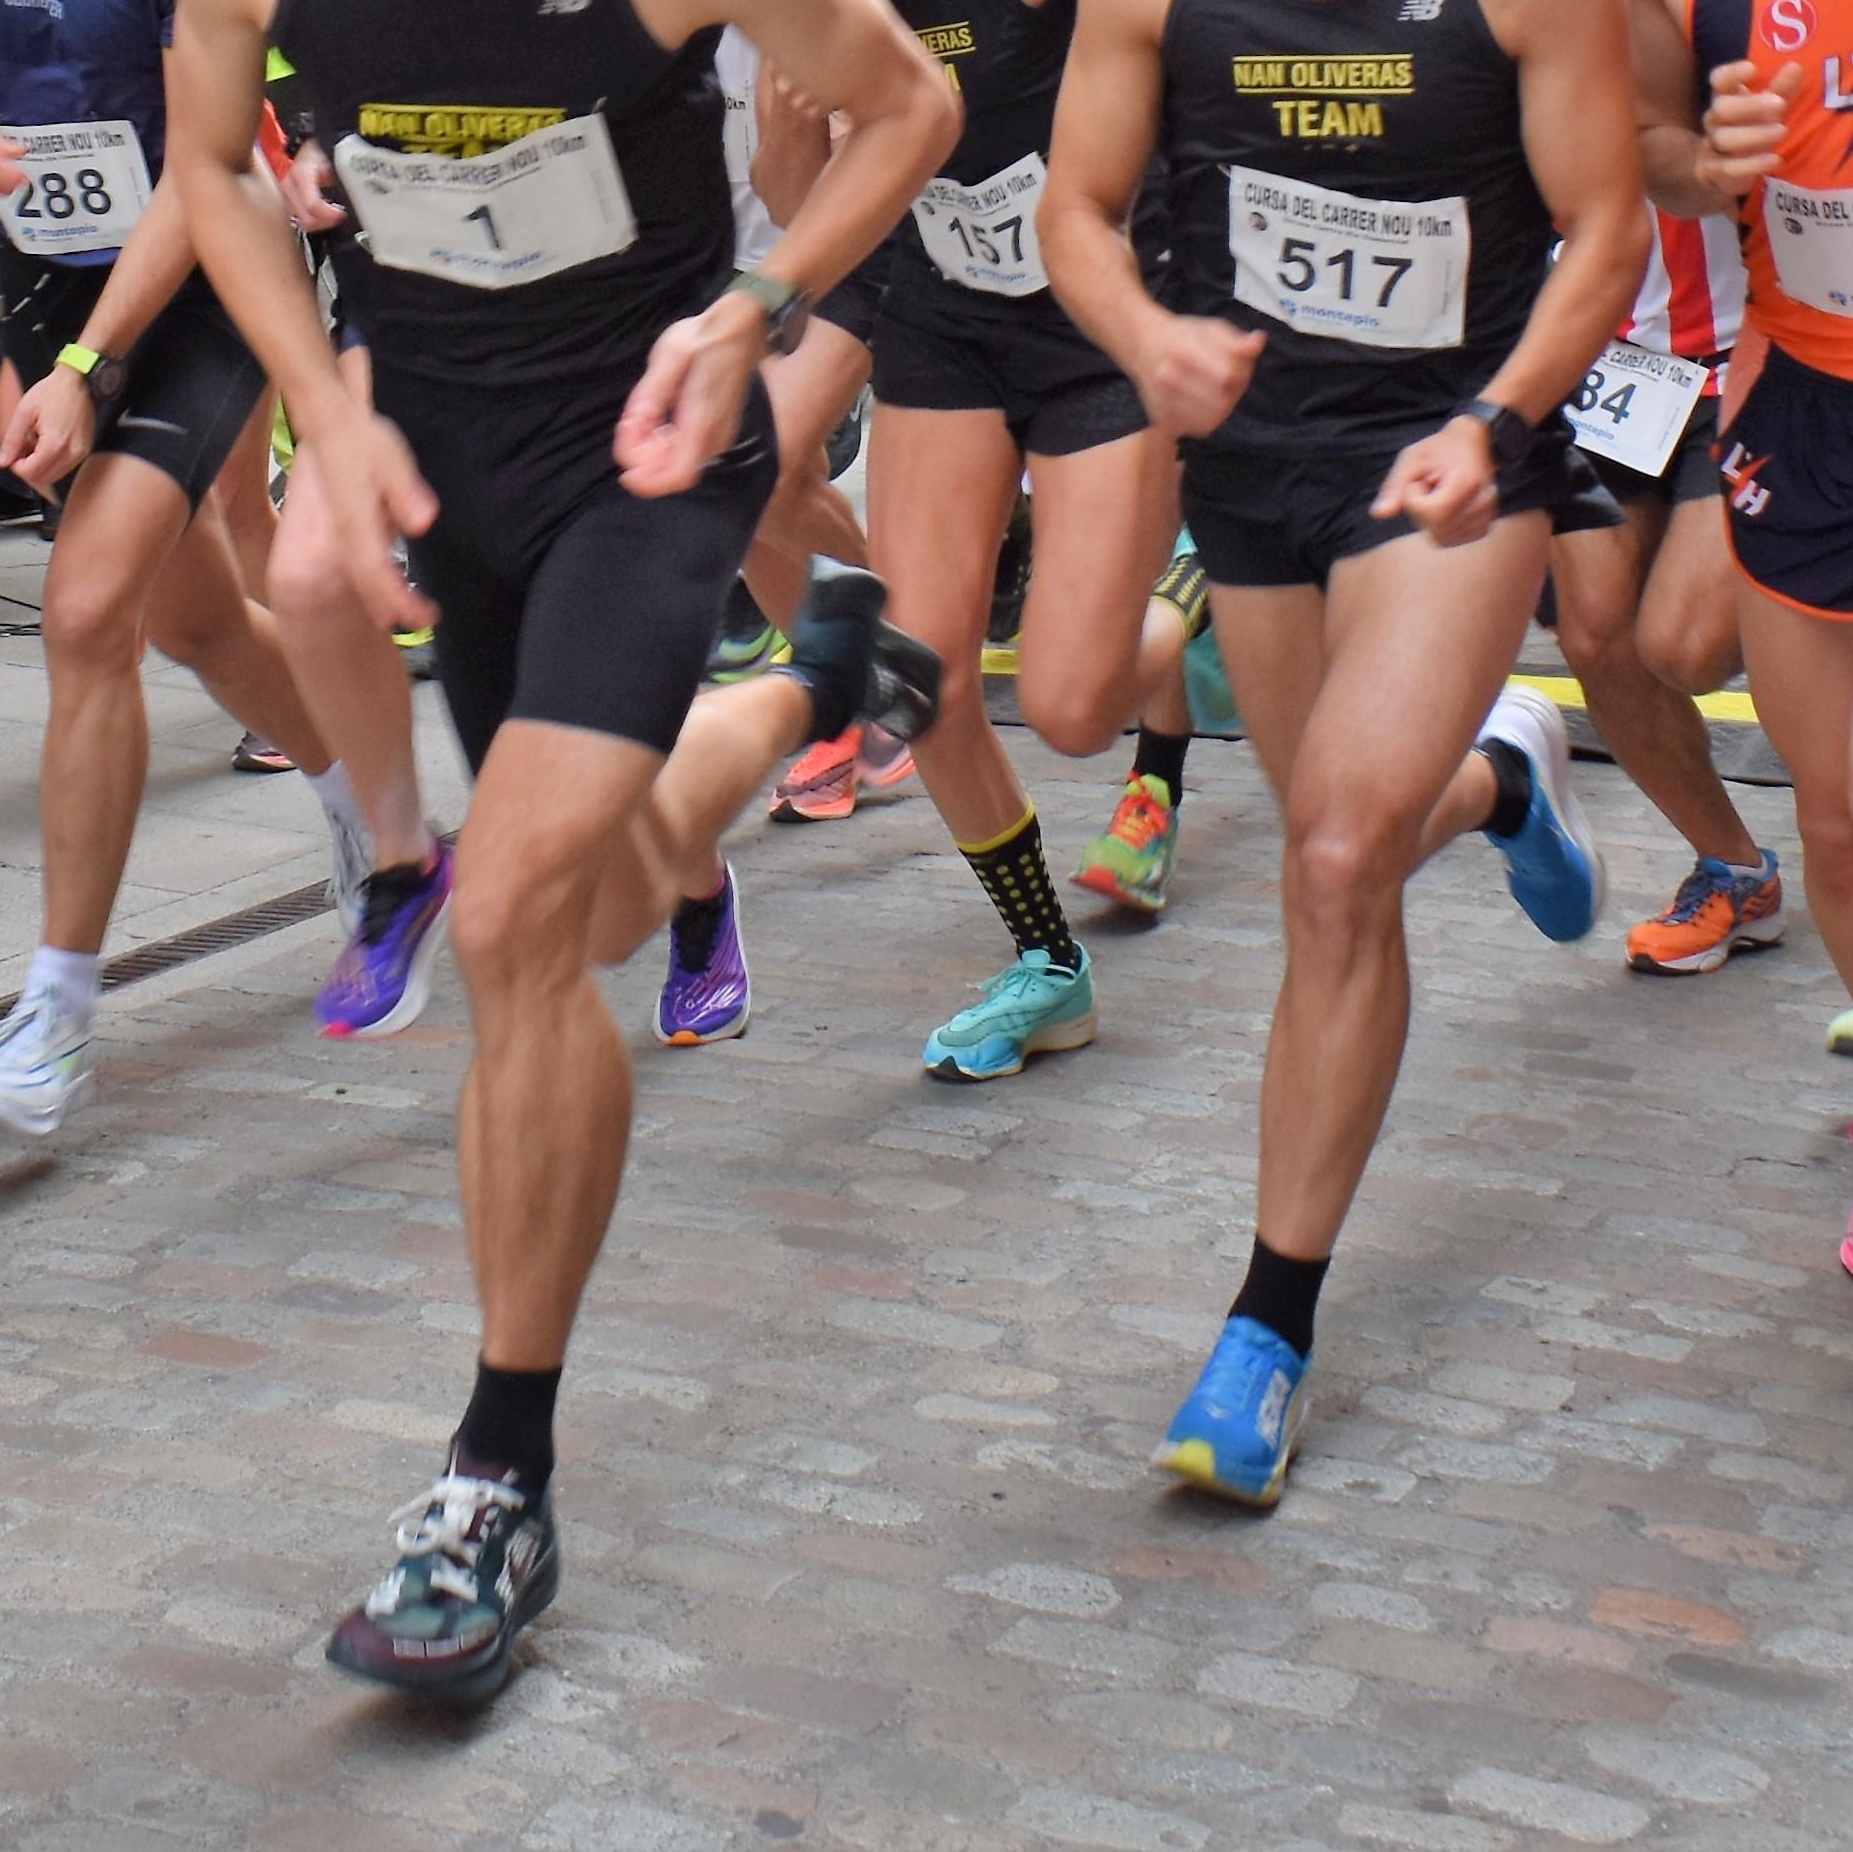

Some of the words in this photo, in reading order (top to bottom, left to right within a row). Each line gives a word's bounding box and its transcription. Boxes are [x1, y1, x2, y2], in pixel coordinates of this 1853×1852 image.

[1232, 62, 1286, 89] NAN
[1290, 61, 1415, 90] OLIVERAS
[1271, 100, 1385, 139] TEAM
[14, 168, 112, 220] 288
[1243, 182, 1289, 214] CURSA
[1292, 195, 1318, 222] DEL
[1320, 202, 1378, 232] CARRER
[1380, 210, 1413, 237] NOU
[1416, 216, 1454, 238] 10km
[1775, 191, 1820, 219] CURSA
[1822, 201, 1849, 220] DEL
[462, 204, 502, 252] 1
[948, 214, 1024, 266] 157
[1276, 236, 1414, 309] 517
[1578, 369, 1637, 425] 84
